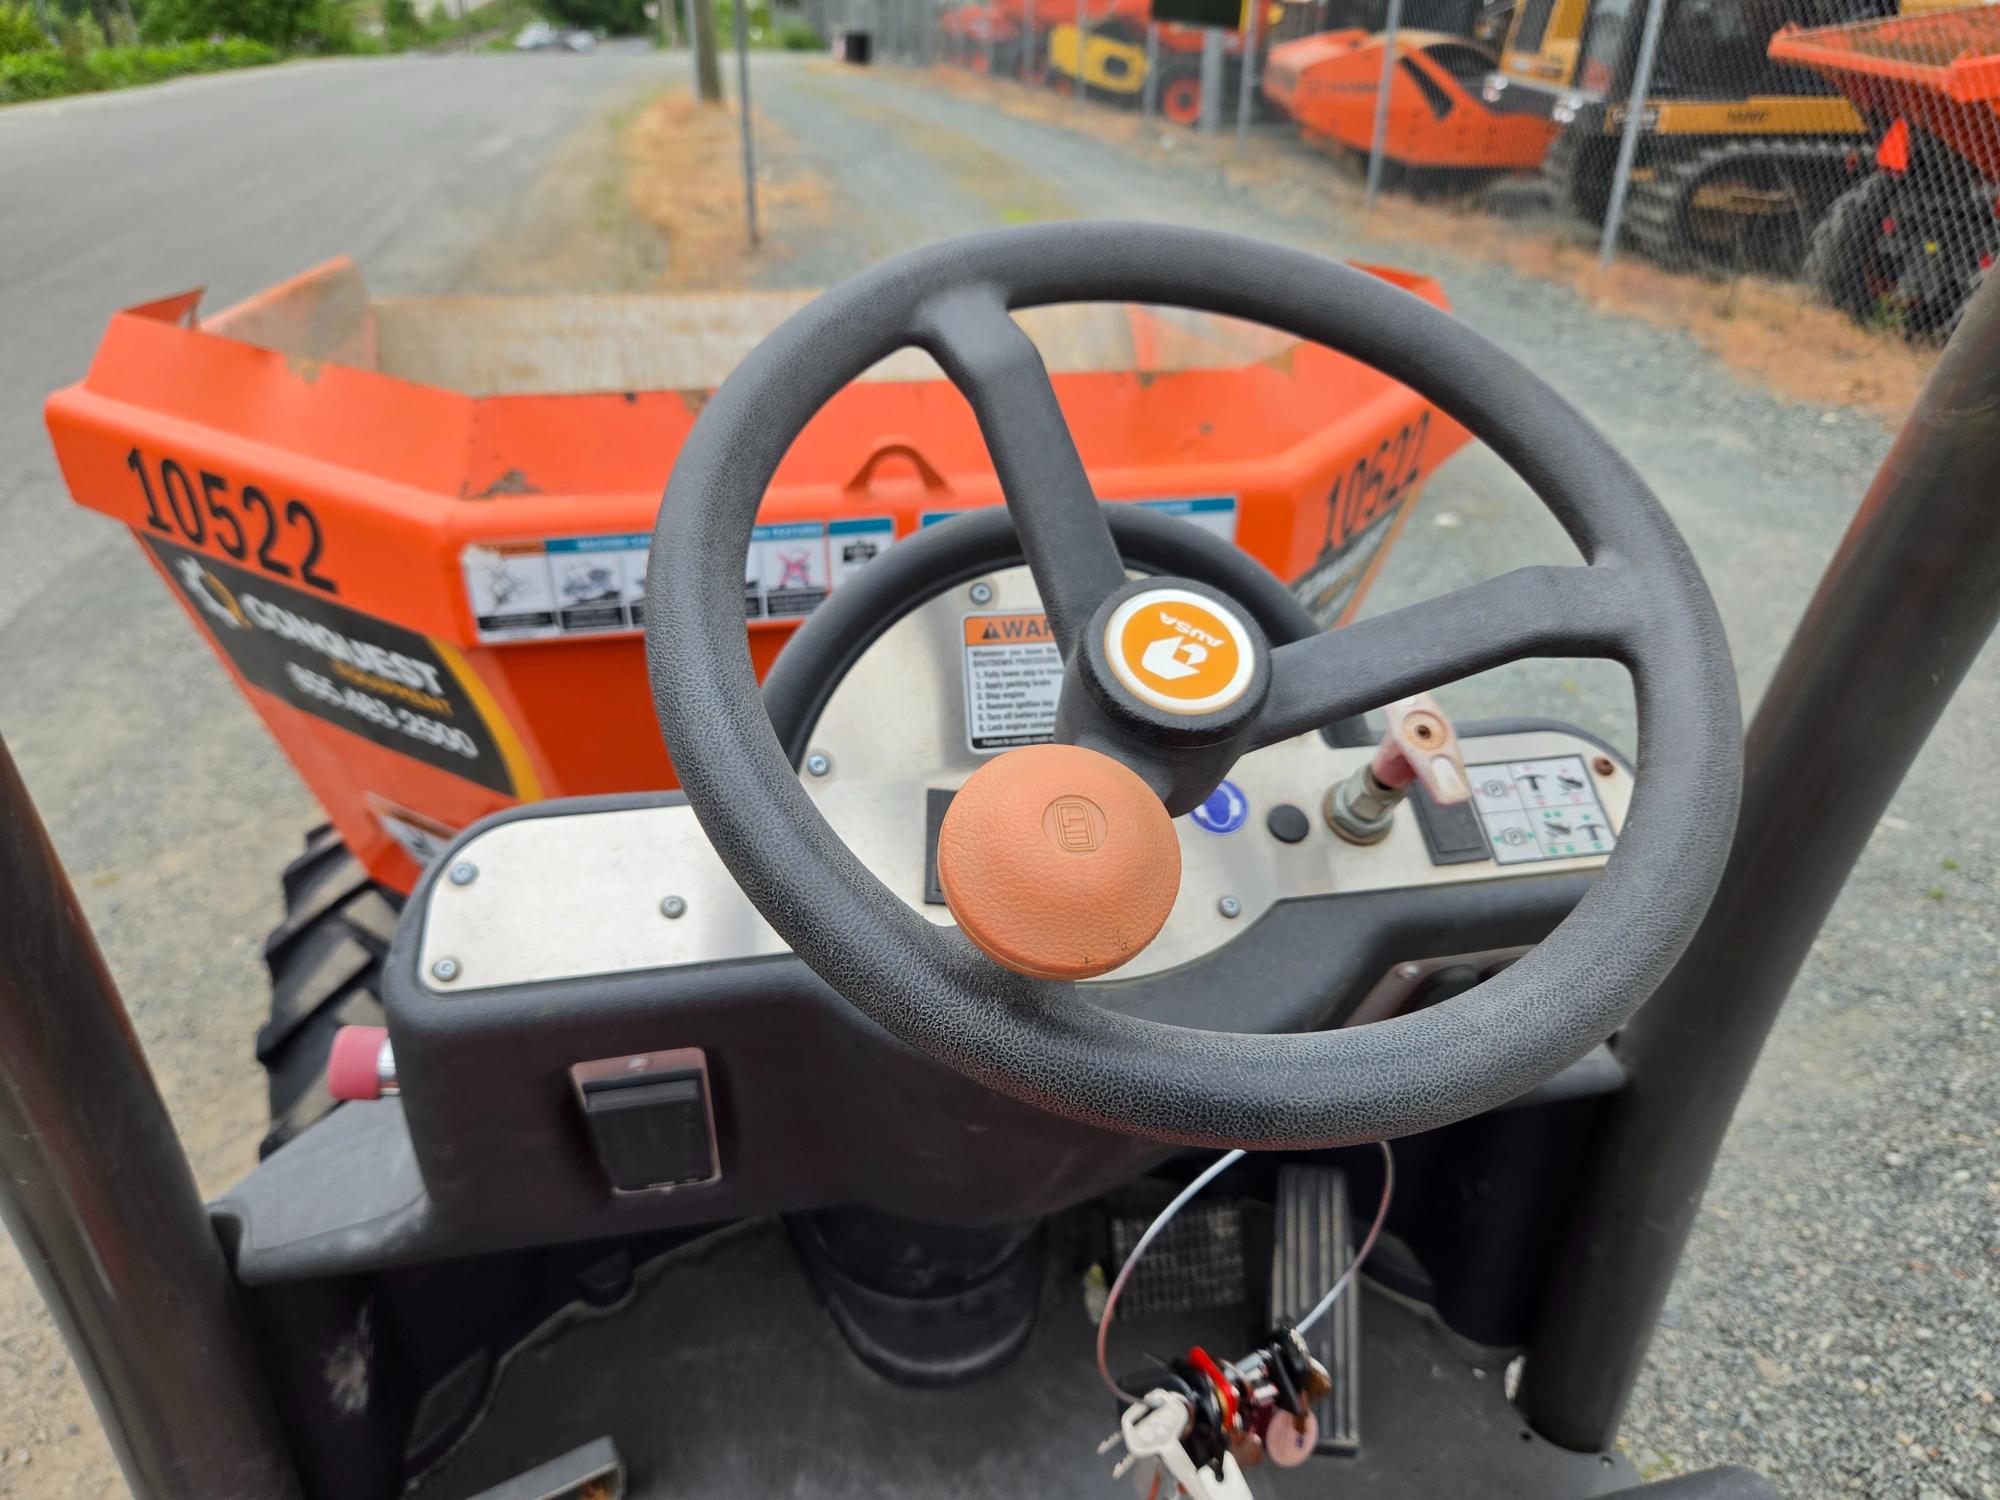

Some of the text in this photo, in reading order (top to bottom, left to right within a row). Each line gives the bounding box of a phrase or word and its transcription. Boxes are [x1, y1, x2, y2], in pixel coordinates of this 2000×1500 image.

[127, 447, 338, 593] 10522
[238, 592, 444, 696] CONQUEST
[1159, 611, 1225, 647] AUSA
